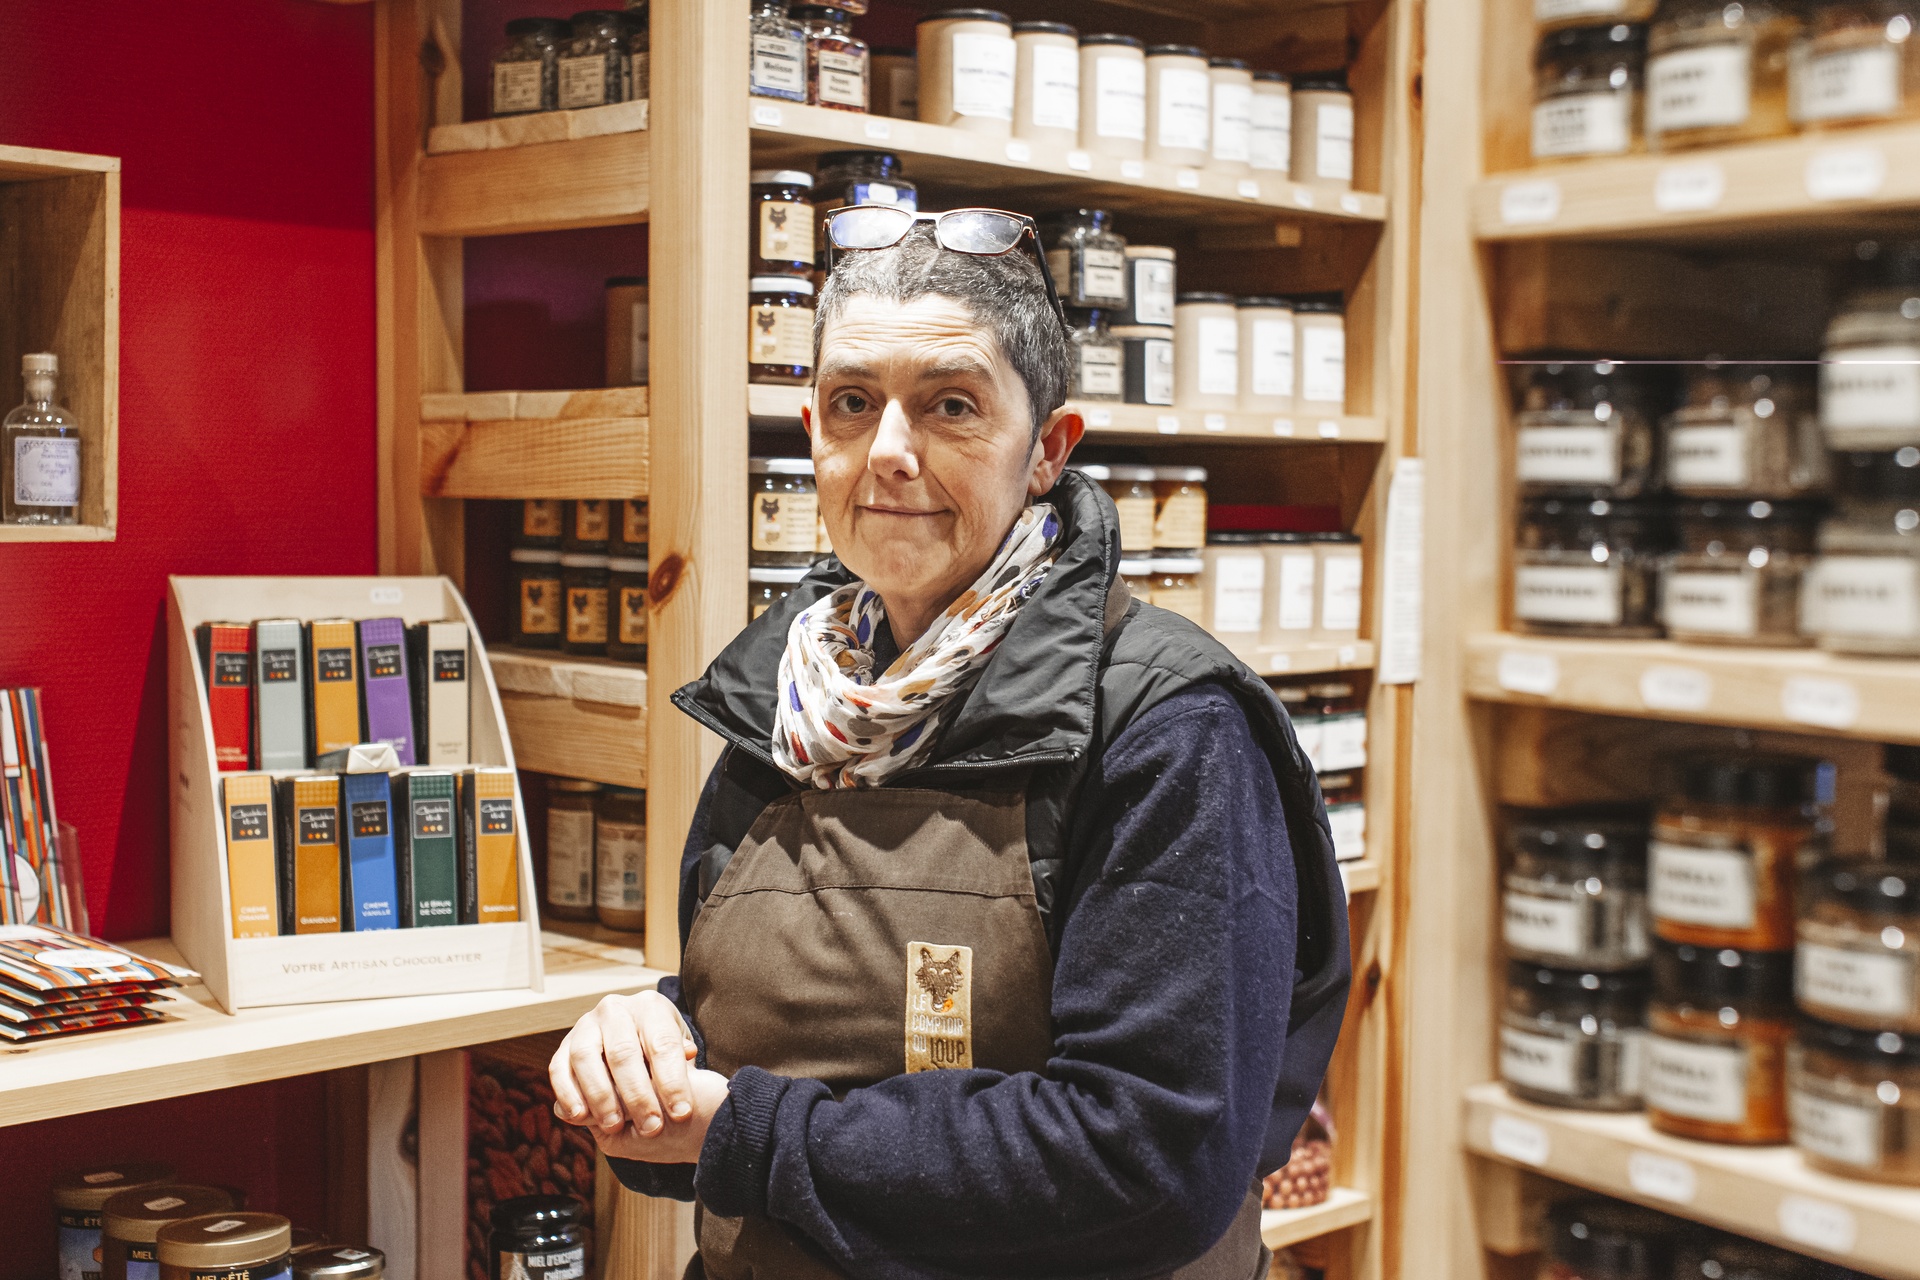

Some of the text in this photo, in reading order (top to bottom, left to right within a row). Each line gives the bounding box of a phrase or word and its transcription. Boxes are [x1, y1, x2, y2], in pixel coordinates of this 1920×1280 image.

[913, 995, 926, 1010] LE
[912, 1015, 963, 1035] COMPTOIR
[930, 1036, 965, 1064] LOUP
[132, 1250, 153, 1260] MIEL
[527, 1255, 546, 1267] MIEL
